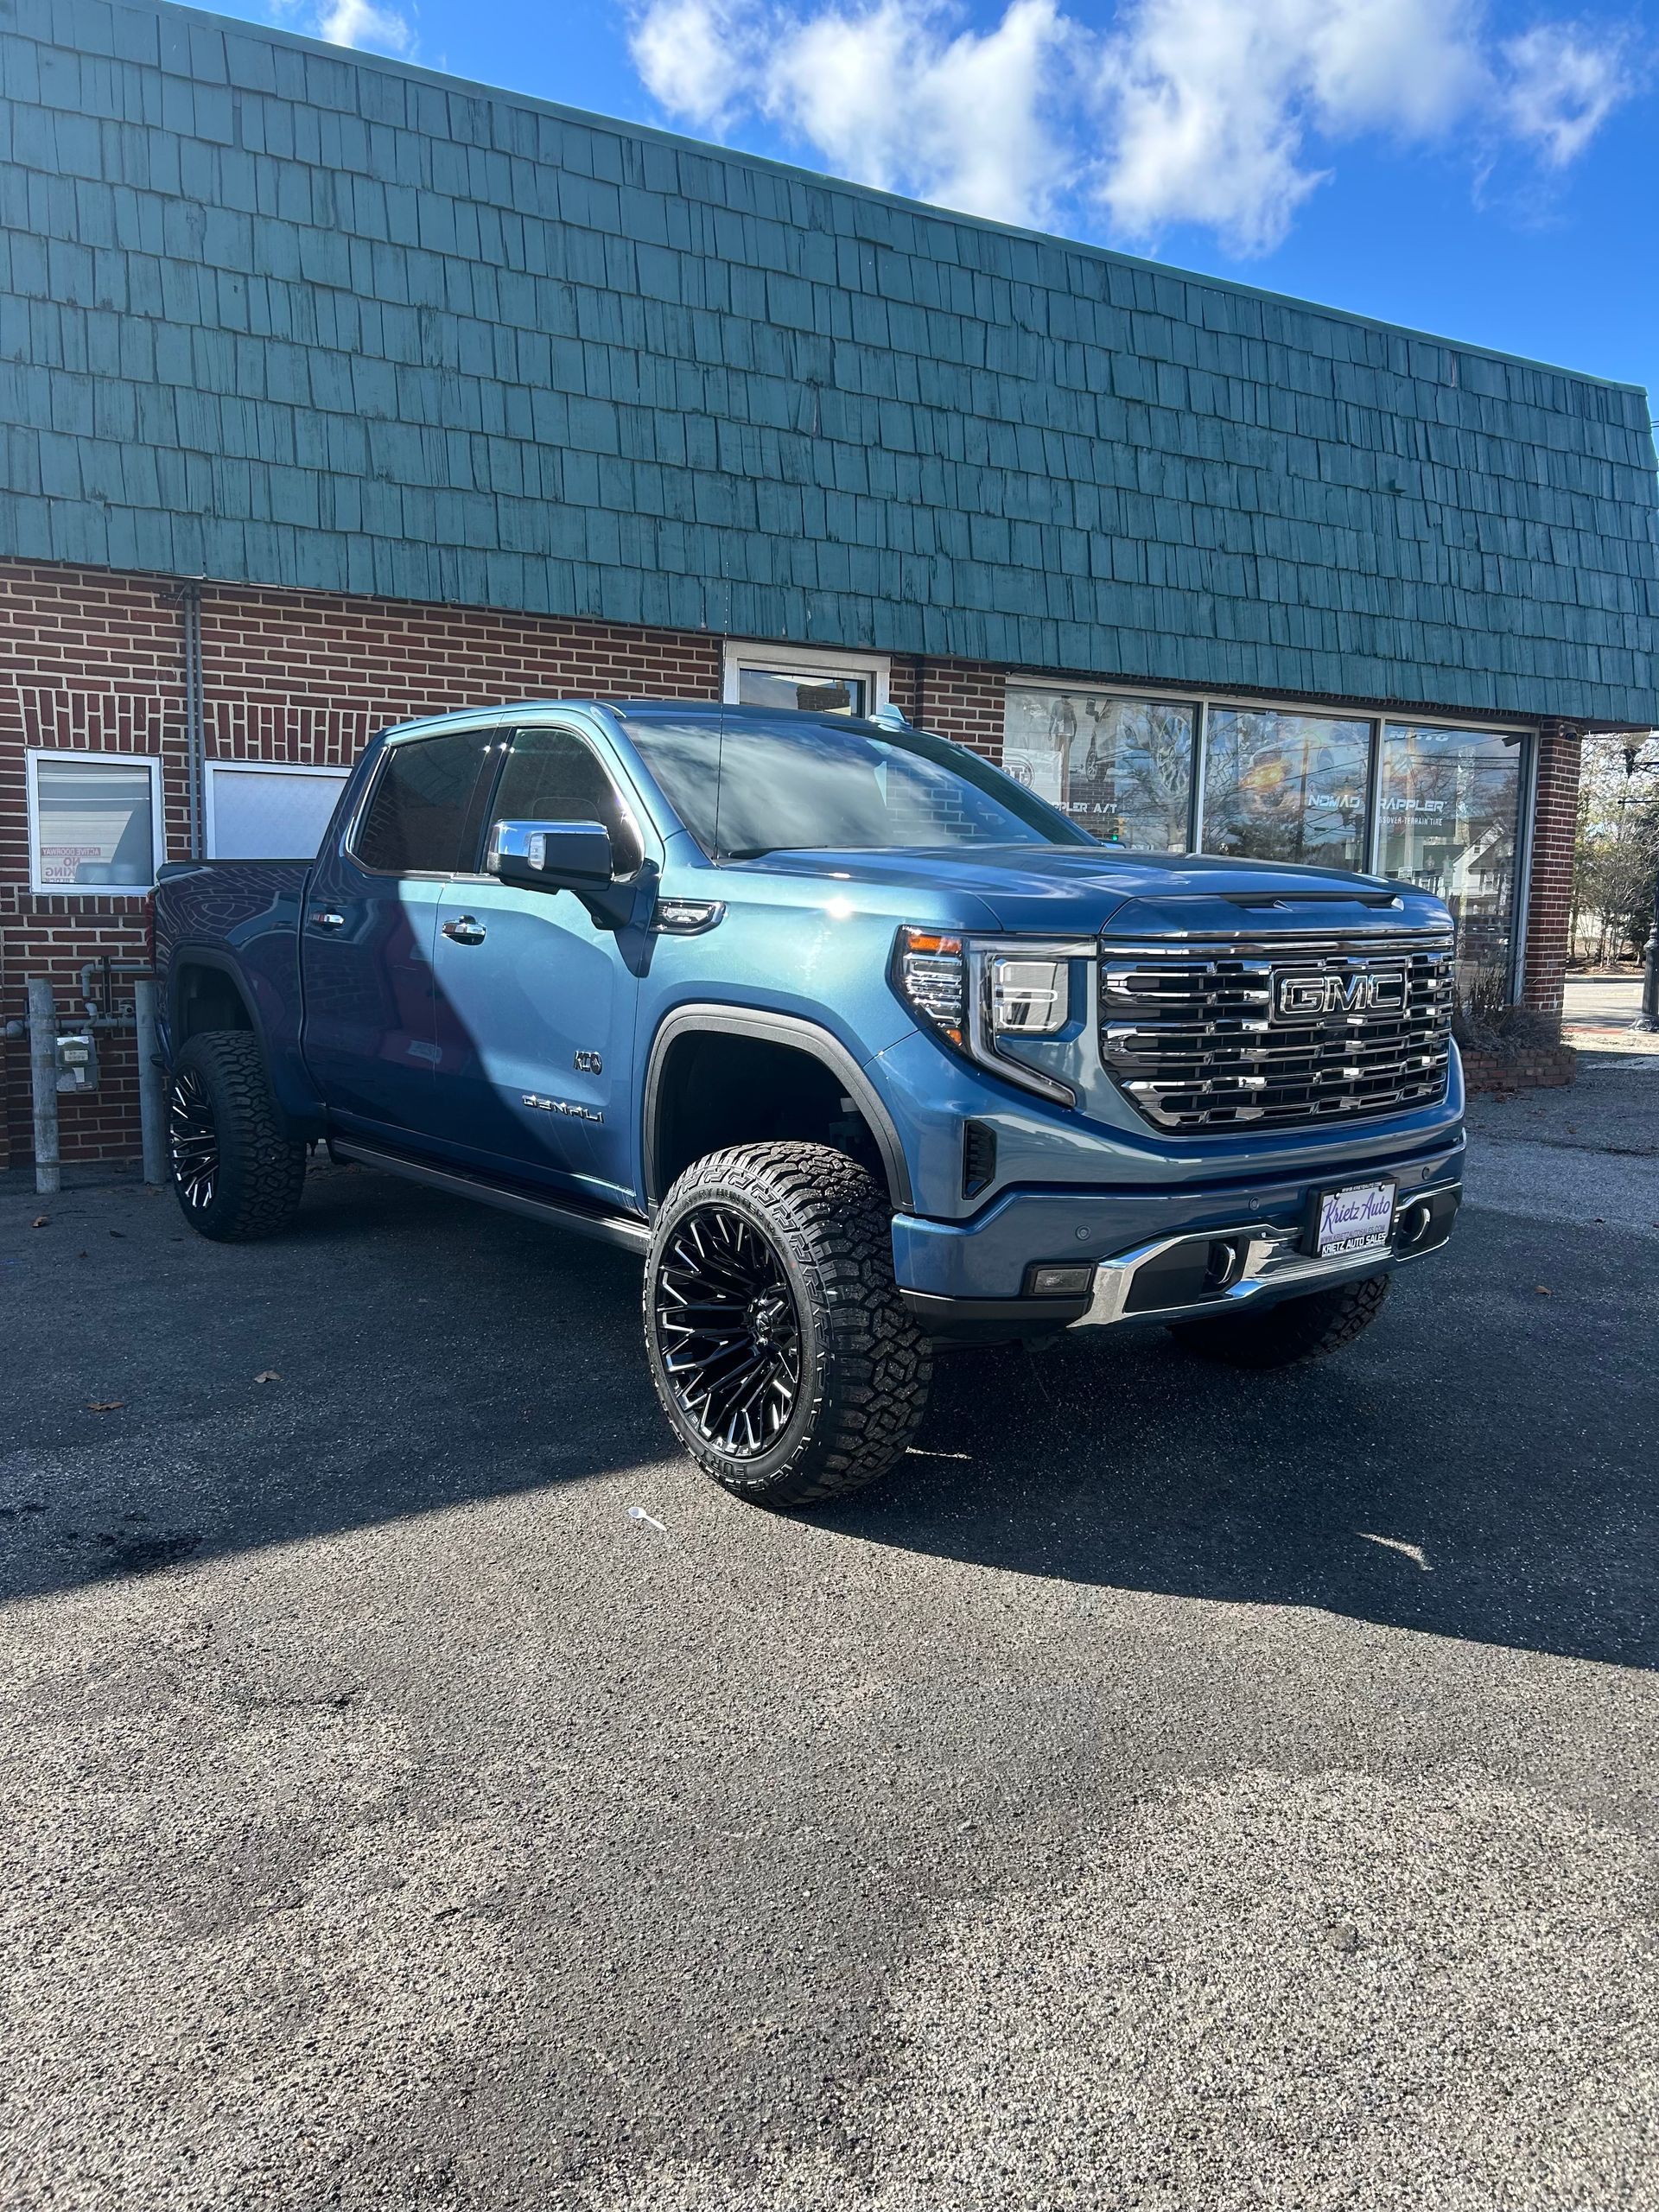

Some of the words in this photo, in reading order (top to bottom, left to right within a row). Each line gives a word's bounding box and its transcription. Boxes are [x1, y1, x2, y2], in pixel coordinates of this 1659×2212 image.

[1093, 803, 1118, 814] A/T
[1308, 794, 1361, 809] NOMAD
[1379, 797, 1445, 812] RAPPLER
[1430, 817, 1443, 826] TIRE
[1281, 974, 1402, 1014] GMC
[522, 1094, 604, 1123] DENALI
[1321, 1199, 1360, 1234] Krietz
[1359, 1192, 1390, 1221] Auto
[1322, 1240, 1346, 1254] KRIETZ
[1346, 1236, 1364, 1249] AUTO
[1365, 1232, 1387, 1244] SALES
